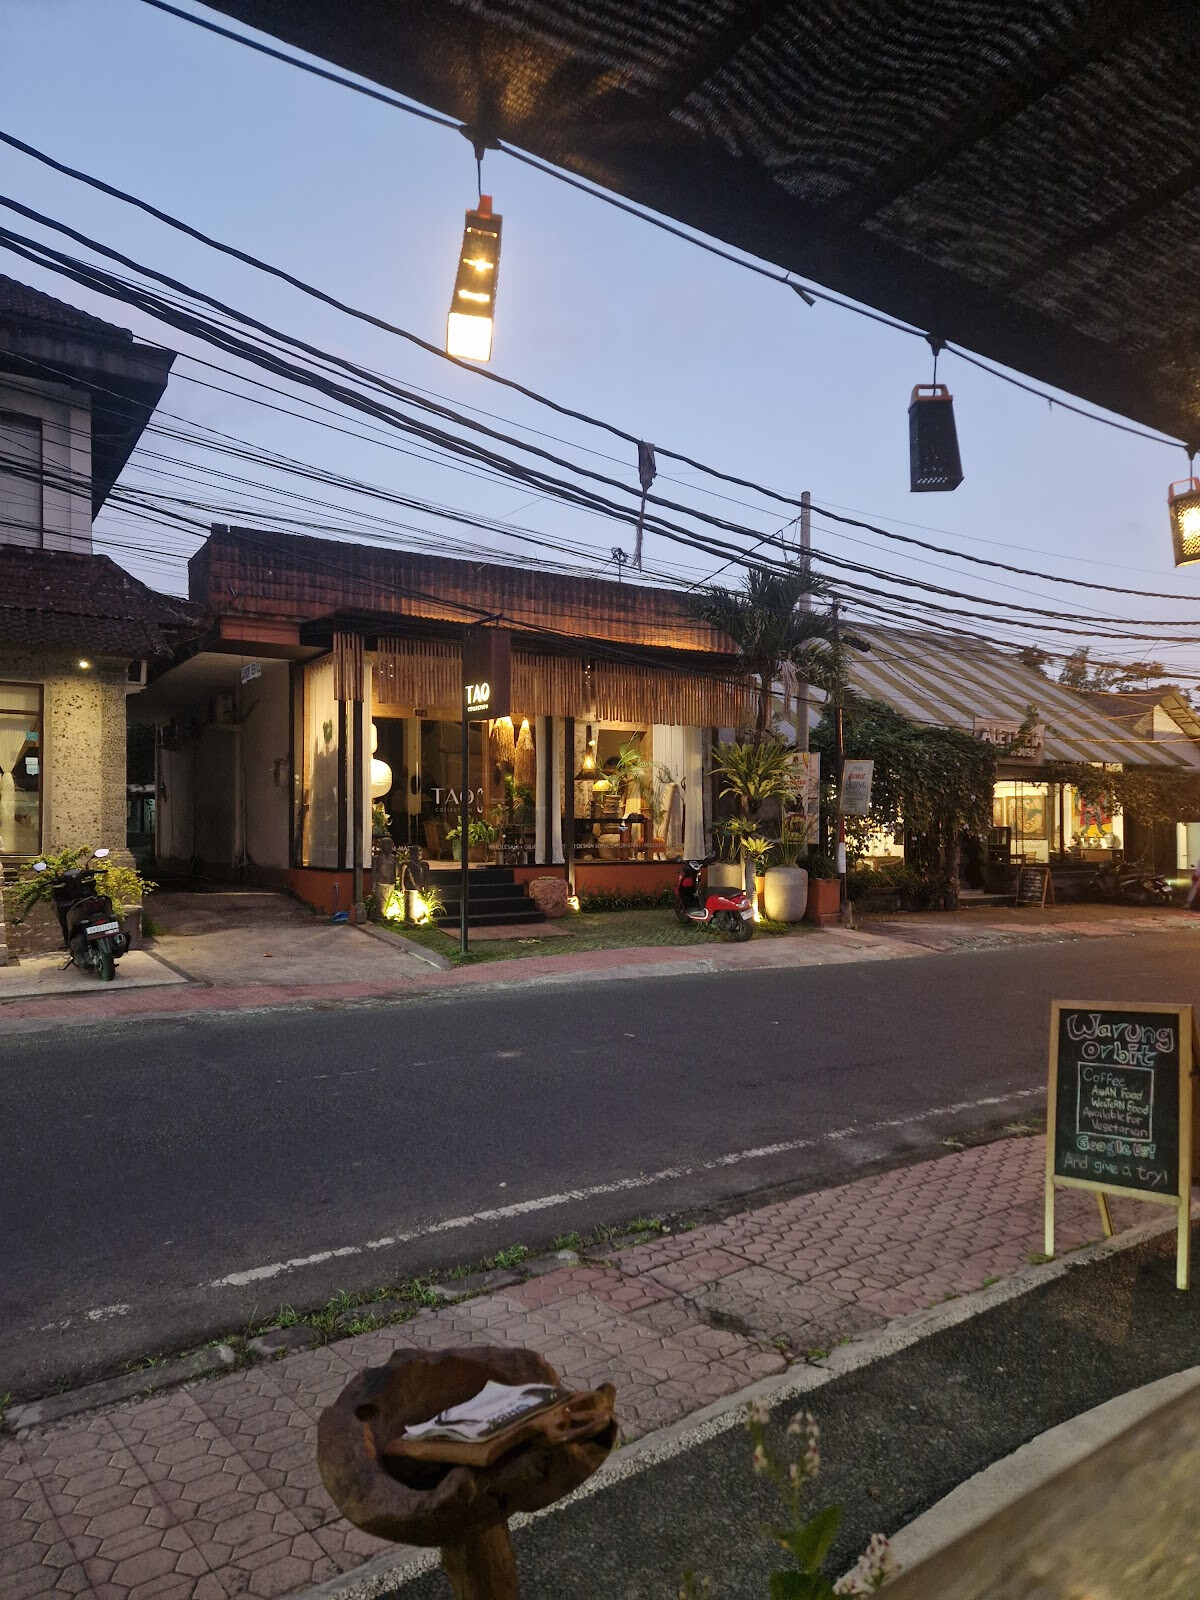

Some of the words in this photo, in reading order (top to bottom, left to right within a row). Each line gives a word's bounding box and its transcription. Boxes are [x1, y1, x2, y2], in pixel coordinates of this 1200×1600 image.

[465, 682, 490, 704] TAO
[430, 787, 474, 804] TAO
[1067, 1014, 1174, 1053] Warung
[1083, 1067, 1126, 1087] Coffee
[1121, 1088, 1143, 1100] Food
[1127, 1101, 1149, 1115] Food
[1091, 1119, 1149, 1137] Vegetarian
[1077, 1135, 1132, 1157] Google
[1063, 1152, 1088, 1169] And
[1093, 1160, 1119, 1174] give
[1122, 1166, 1132, 1177] a
[1136, 1164, 1168, 1187] try!
